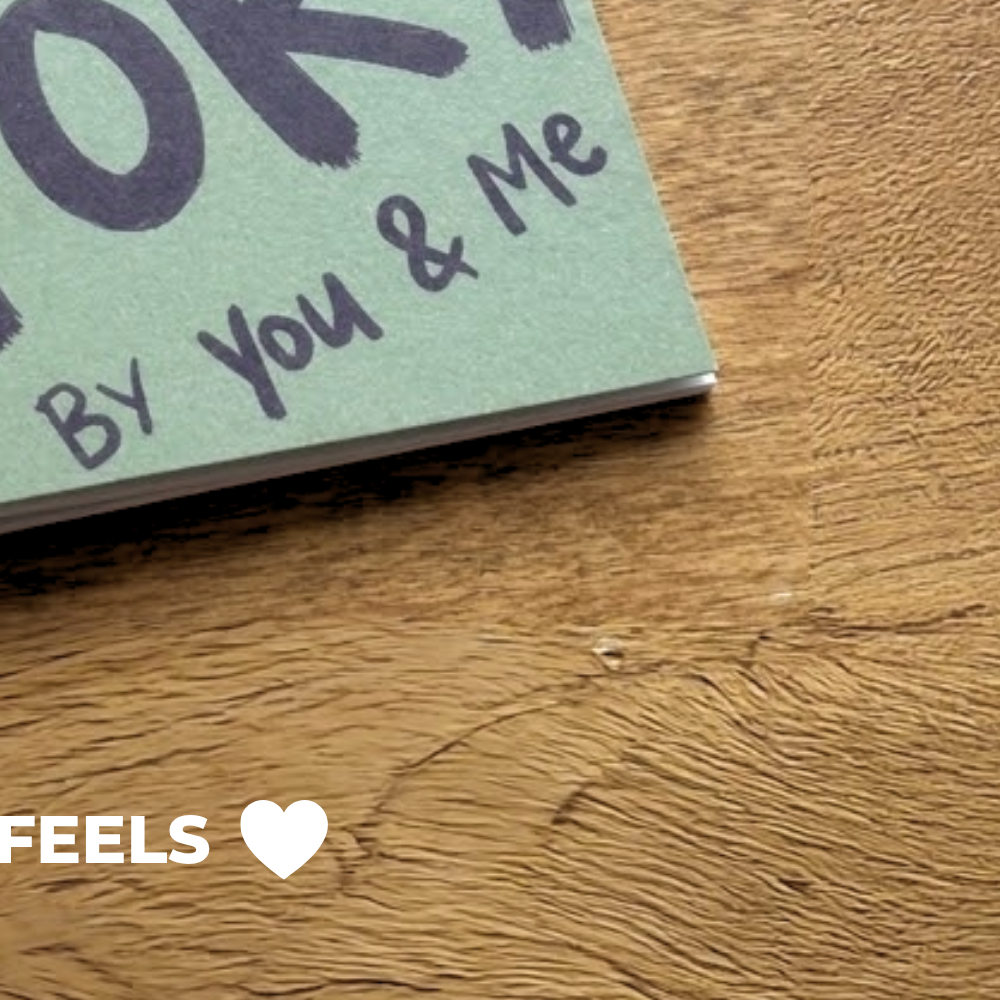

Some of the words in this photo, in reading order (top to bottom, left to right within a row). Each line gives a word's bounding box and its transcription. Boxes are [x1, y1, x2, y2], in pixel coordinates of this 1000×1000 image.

[196, 270, 384, 421] You
[376, 194, 479, 293] &
[466, 110, 609, 237] Me
